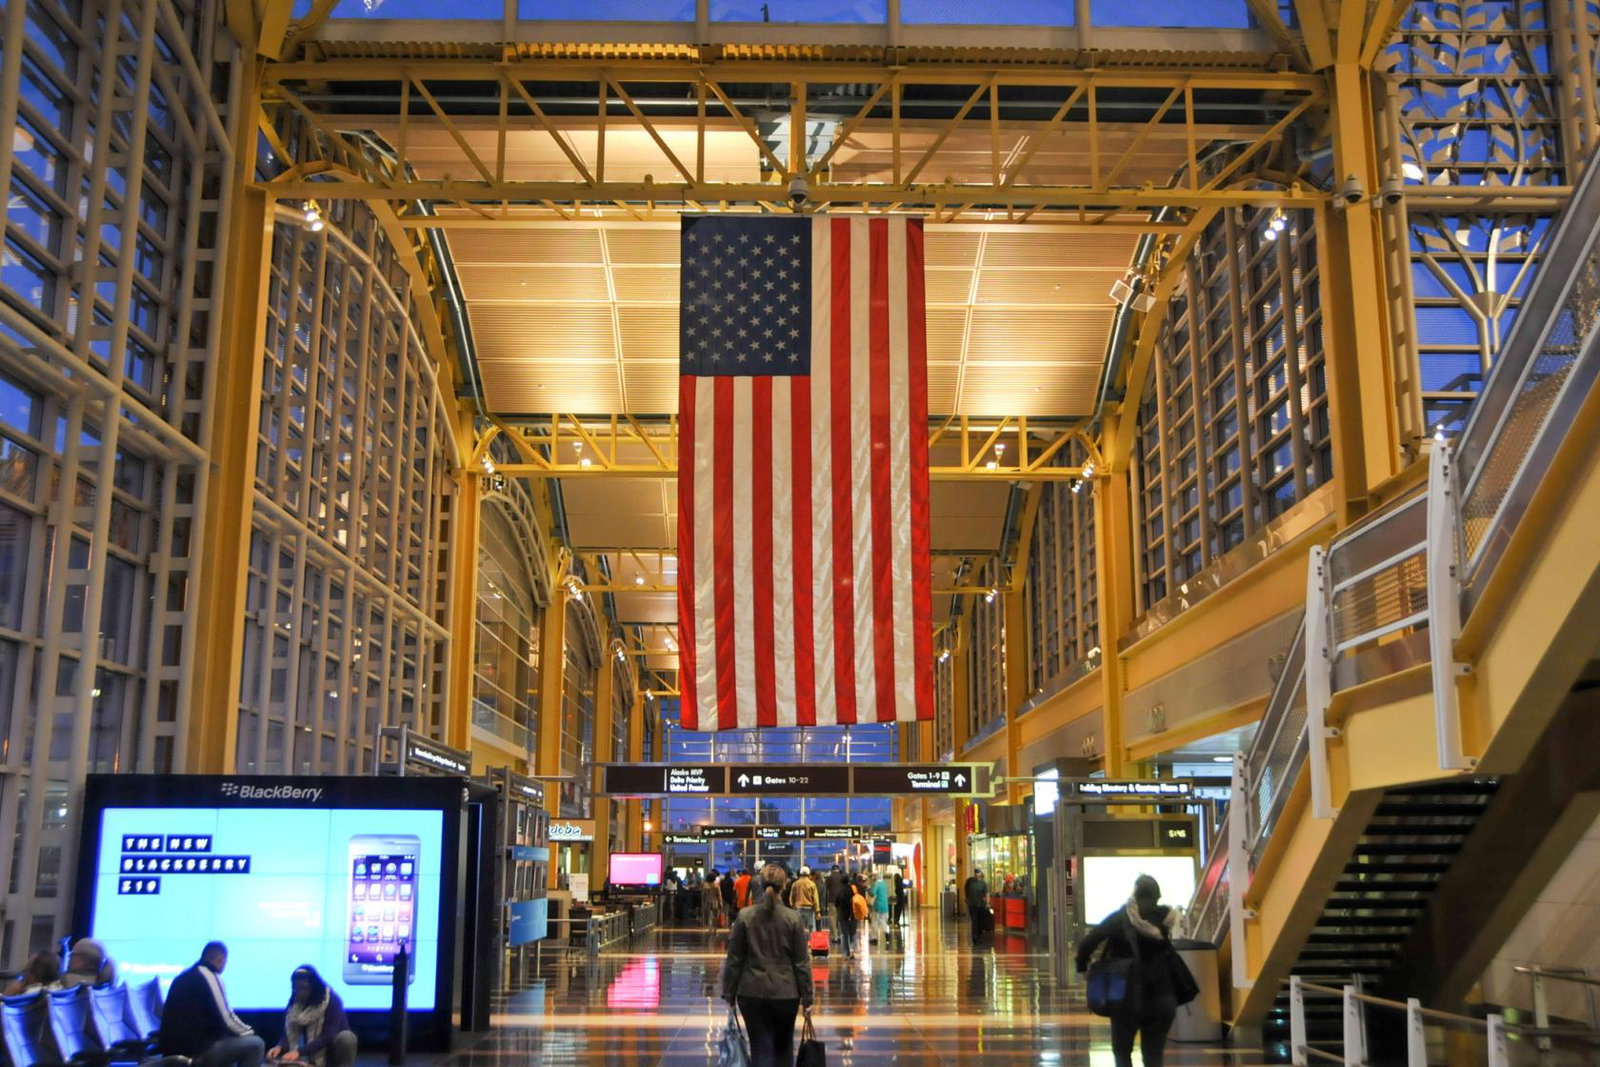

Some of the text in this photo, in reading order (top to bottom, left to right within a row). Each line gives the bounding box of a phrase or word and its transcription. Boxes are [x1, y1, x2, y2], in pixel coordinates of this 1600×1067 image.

[670, 768, 689, 776] Alaska
[907, 771, 940, 780] Gates 1-9
[669, 776, 706, 786] Delta Priority
[764, 776, 809, 784] Gates 10-22
[911, 780, 941, 789] Terminal
[669, 783, 688, 792] United
[239, 785, 323, 802] BlackBerry
[548, 821, 581, 837] doba
[123, 837, 210, 851] THE NEW
[122, 857, 249, 872] BLACKBERRY
[120, 879, 159, 894] Z10
